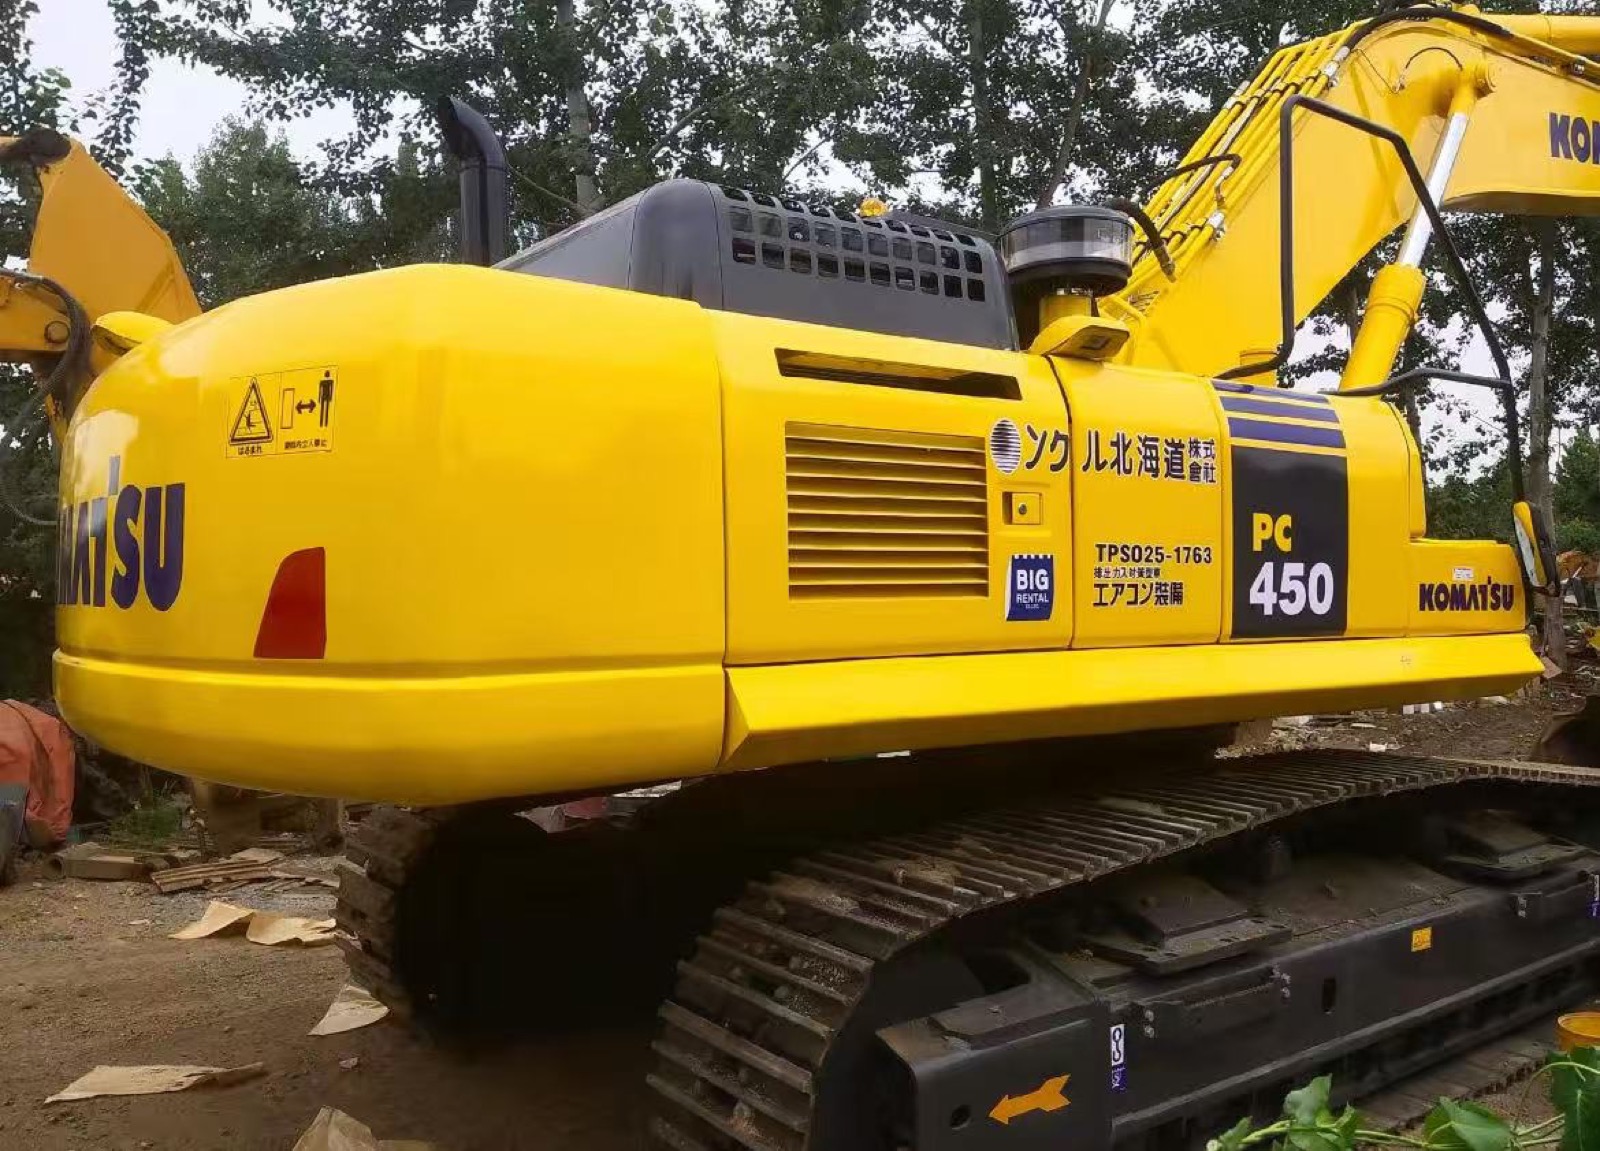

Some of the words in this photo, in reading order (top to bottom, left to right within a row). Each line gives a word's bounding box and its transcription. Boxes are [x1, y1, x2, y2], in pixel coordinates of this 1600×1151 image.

[1252, 512, 1292, 552] PC
[1016, 568, 1049, 590] BIG
[1092, 581, 1184, 607] エアコン装備
[1249, 561, 1334, 616] 450
[1418, 575, 1514, 612] KOMATSU
[1016, 592, 1049, 604] RENTAL
